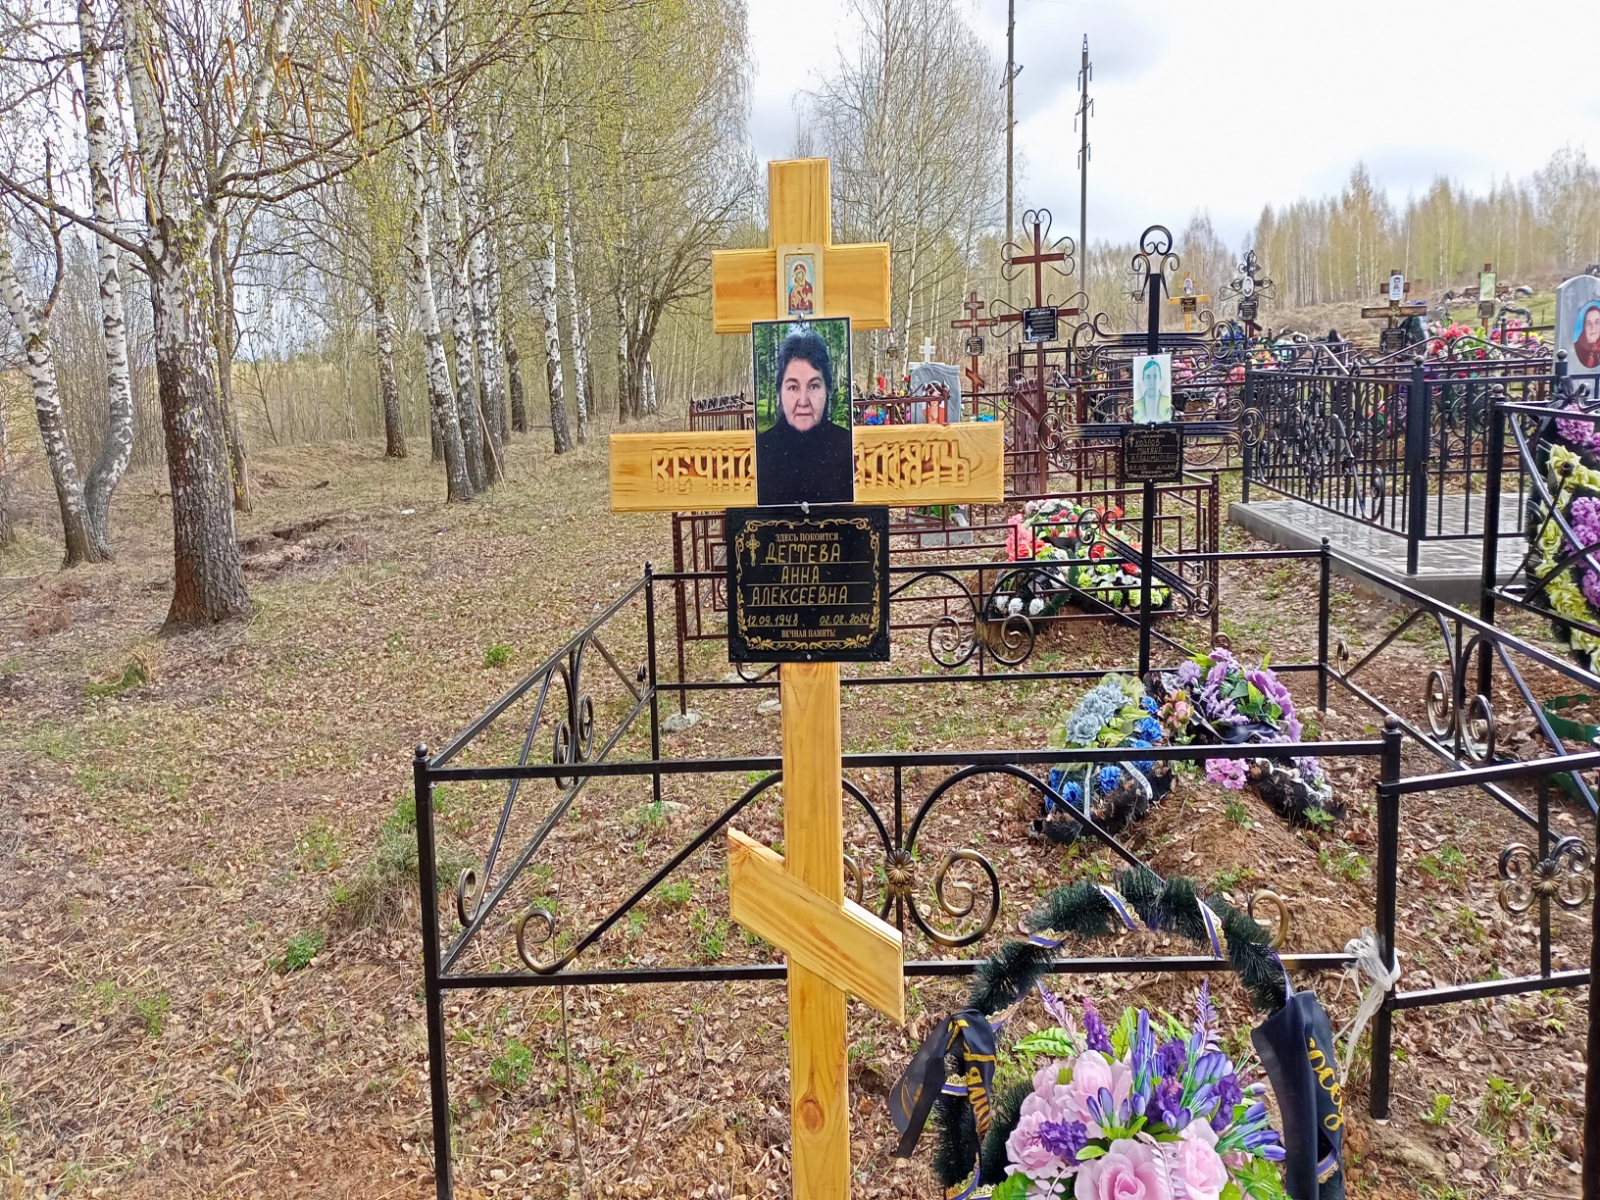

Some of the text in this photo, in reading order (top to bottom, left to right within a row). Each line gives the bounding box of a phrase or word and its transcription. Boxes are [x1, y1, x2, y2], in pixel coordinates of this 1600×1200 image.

[651, 446, 755, 495] ВЕЧНА
[774, 532, 839, 543] ЗДЕСЬ ПОКОИТСЯ
[765, 542, 841, 564] ДЕГТЕВА
[781, 565, 820, 584] АННА
[751, 585, 848, 606] АЛЕКСЕЕВНА
[746, 612, 799, 626] 12.09.1948
[781, 628, 836, 638] ВЕЧНАЯ ПАМЯТЬ!
